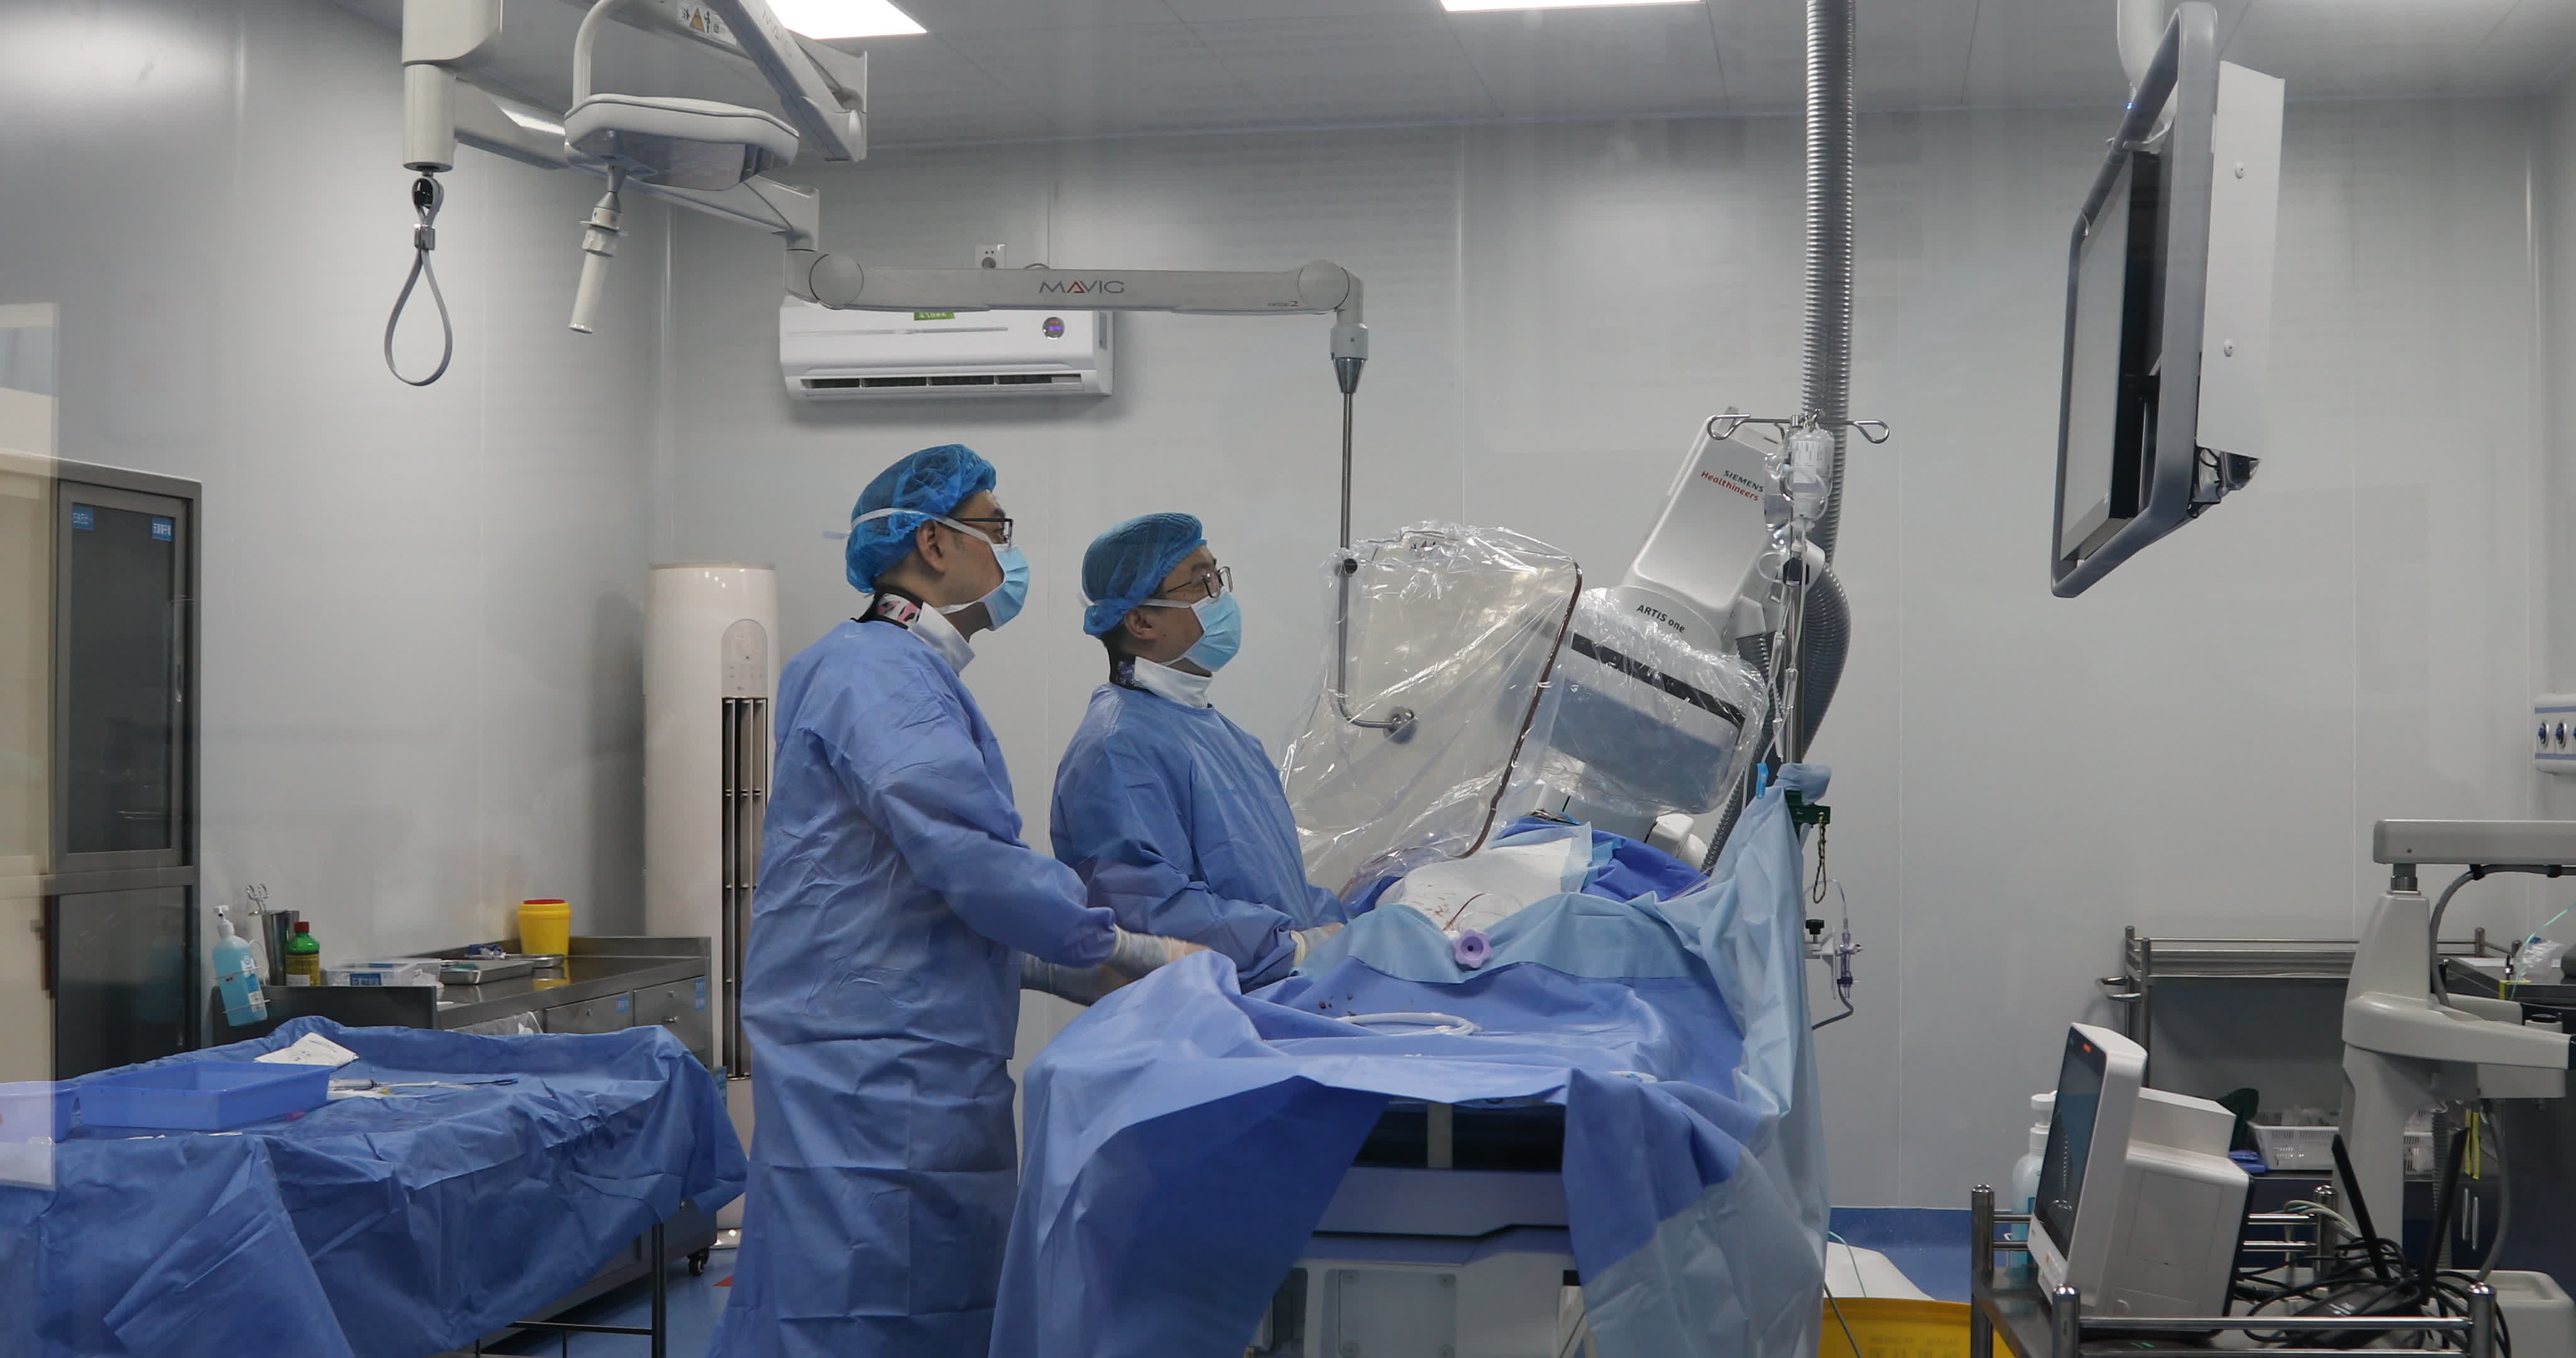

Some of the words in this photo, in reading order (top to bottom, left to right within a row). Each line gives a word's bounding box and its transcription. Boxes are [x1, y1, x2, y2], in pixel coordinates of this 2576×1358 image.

[1039, 280, 1124, 294] MAVIG
[1701, 471, 1758, 501] Healthineers
[1724, 470, 1764, 492] SIEMENS
[1636, 605, 1667, 622] ARTIS
[1668, 619, 1685, 633] one
